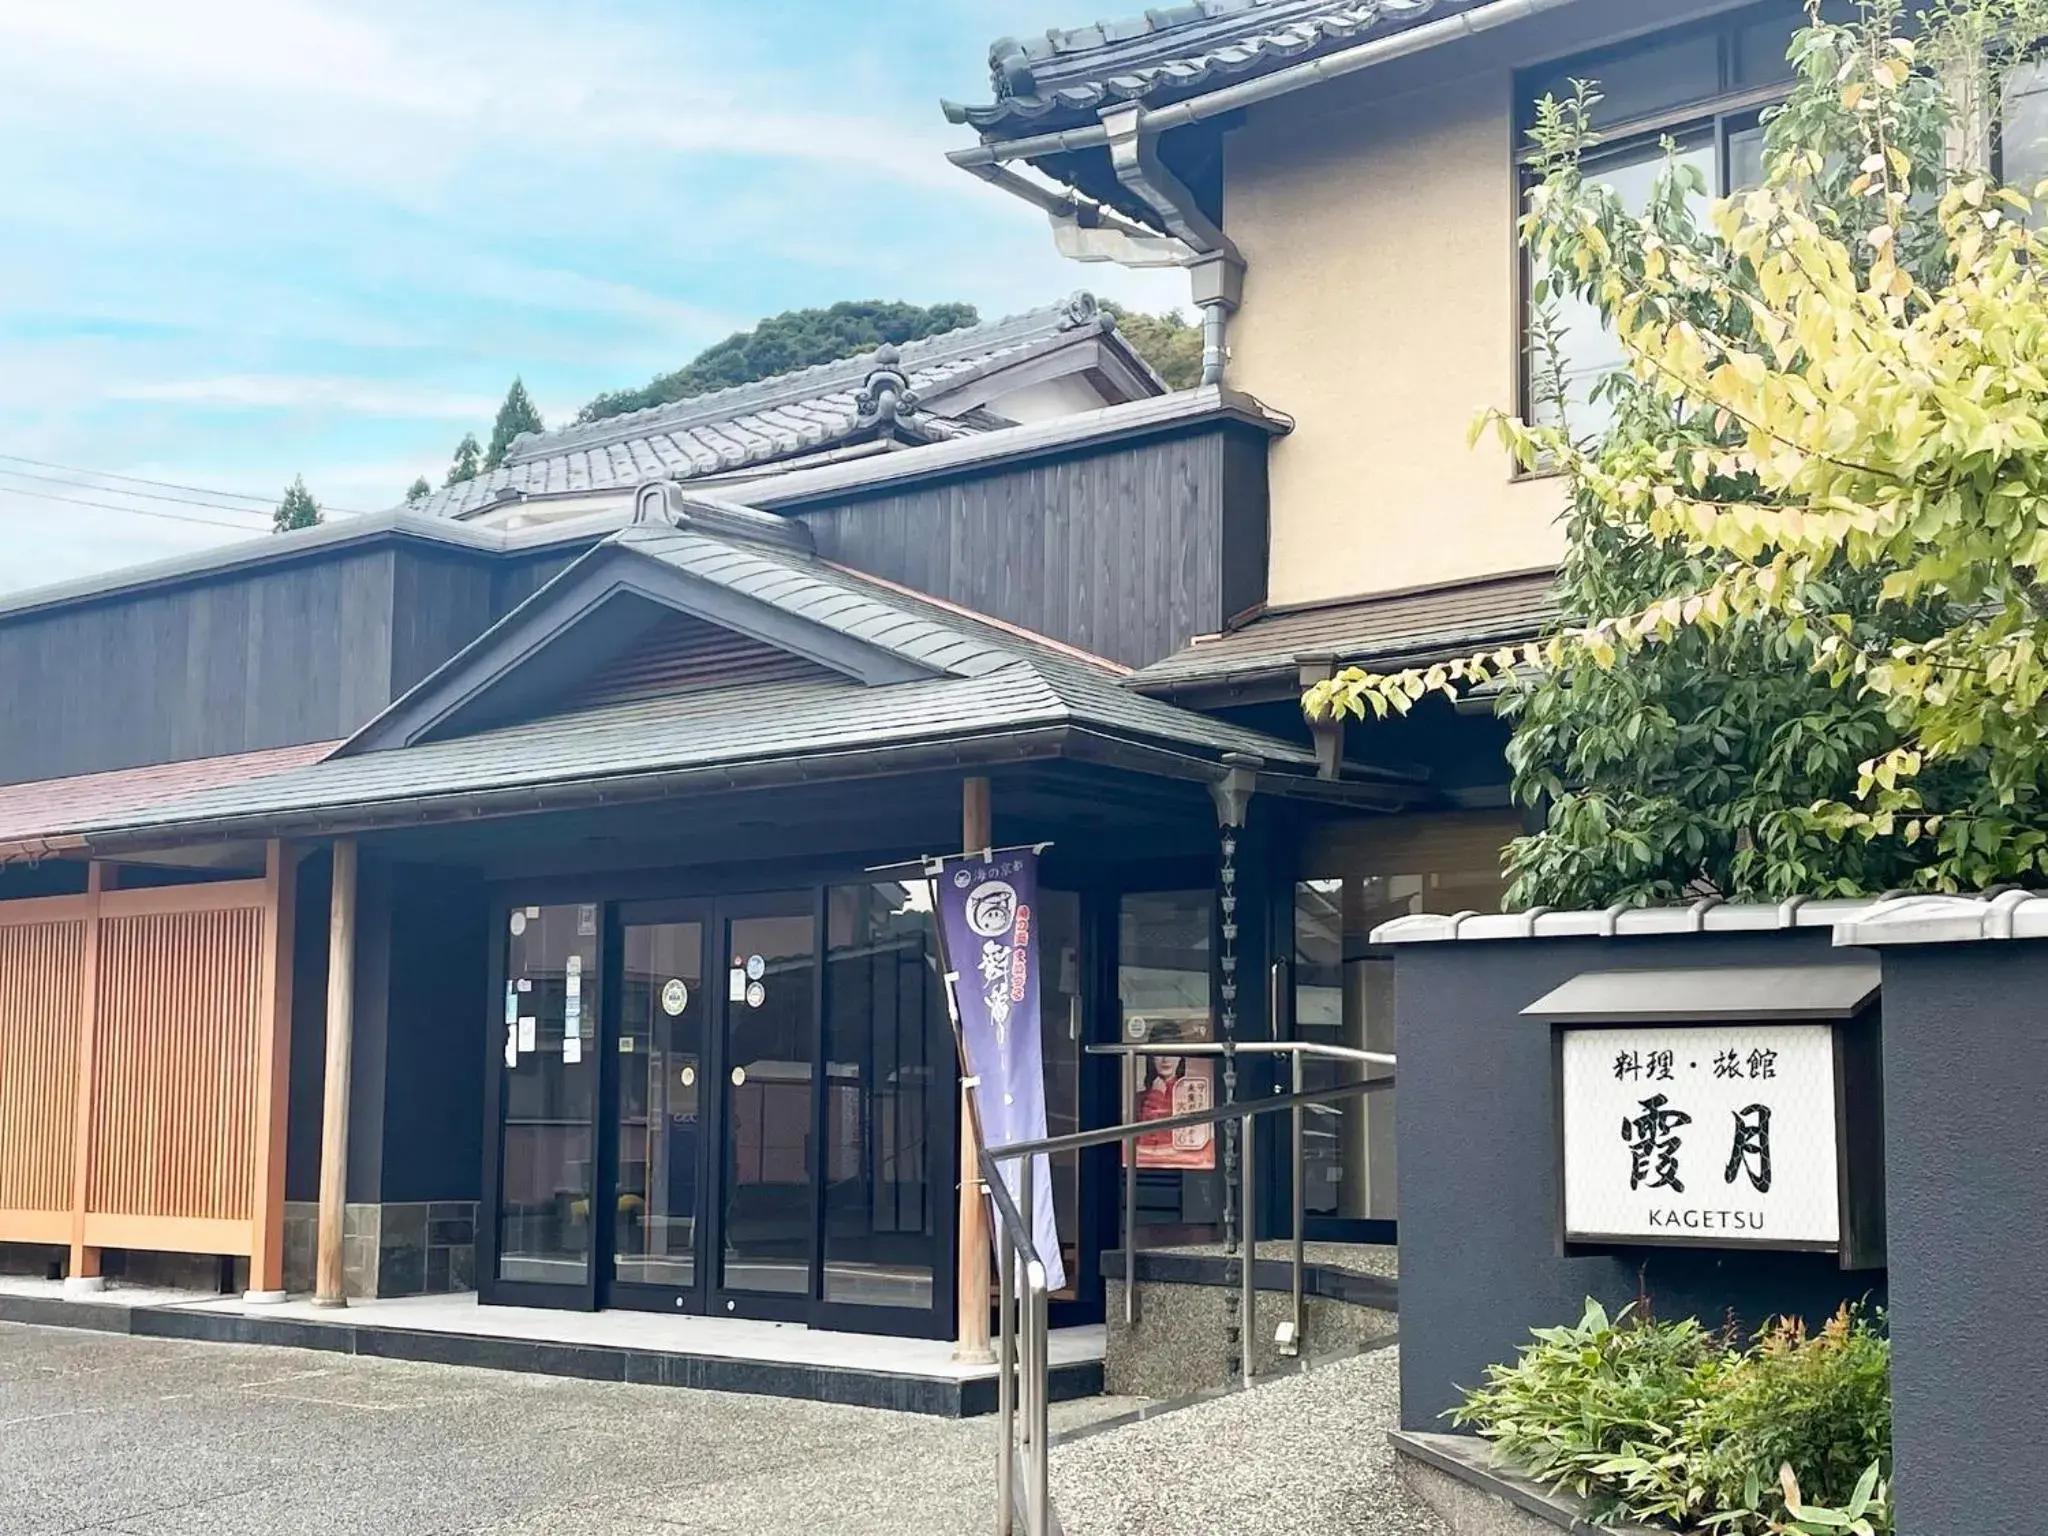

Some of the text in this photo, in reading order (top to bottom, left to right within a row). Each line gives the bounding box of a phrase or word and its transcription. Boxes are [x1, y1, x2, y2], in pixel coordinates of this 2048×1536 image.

[1612, 1048, 1778, 1081] 料理・旅館
[1621, 1093, 1772, 1193] 霞月
[1648, 1209, 1765, 1230] KAGETSU
